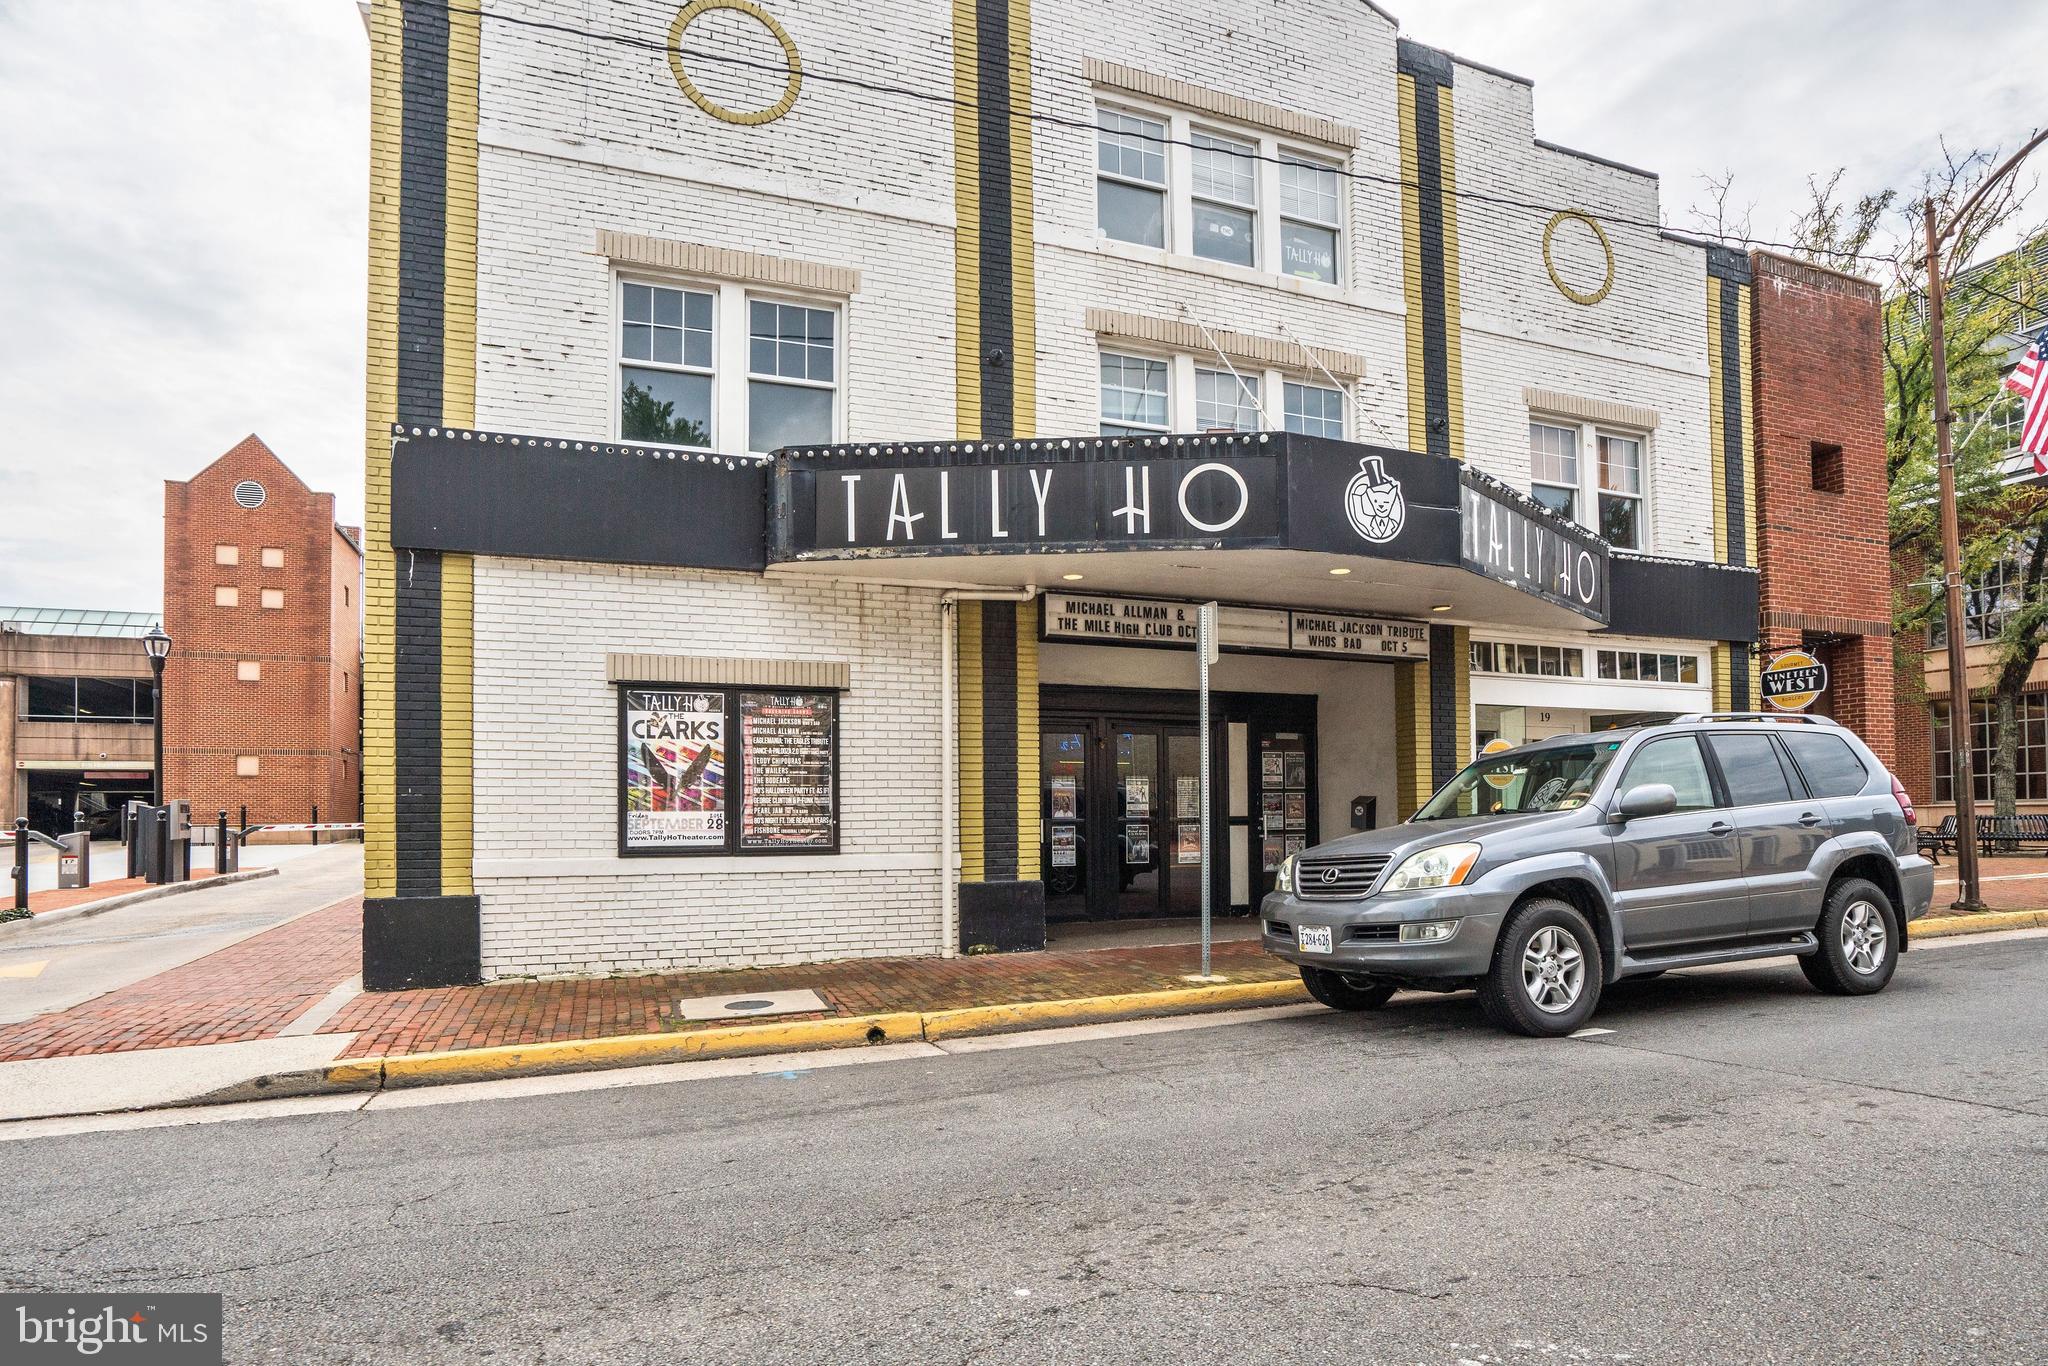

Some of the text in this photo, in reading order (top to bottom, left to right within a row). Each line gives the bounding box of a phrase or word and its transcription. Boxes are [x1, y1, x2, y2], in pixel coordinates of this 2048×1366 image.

[841, 462, 1249, 542] TALLY HO
[1471, 493, 1595, 604] TALLY HO
[1066, 601, 1185, 621] MICHAEL ALLMAN &
[1057, 617, 1078, 631] THE
[1085, 619, 1110, 633] MILE
[1145, 622, 1173, 636] CLUB
[1178, 625, 1197, 639] OCT
[1296, 618, 1424, 640] MICHAEL JACKSON TRIBUTE
[1308, 635, 1408, 652] WHOS BAD OCT 5
[1767, 668, 1819, 681] NINETEEN
[1769, 676, 1817, 694] WEST
[643, 695, 682, 711] TALLY
[771, 697, 790, 706] TALLY
[1540, 712, 1550, 722] 19
[632, 720, 720, 740] CLARKS
[628, 818, 723, 830] SEPTEMBER 28
[1305, 933, 1330, 946] 284-626
